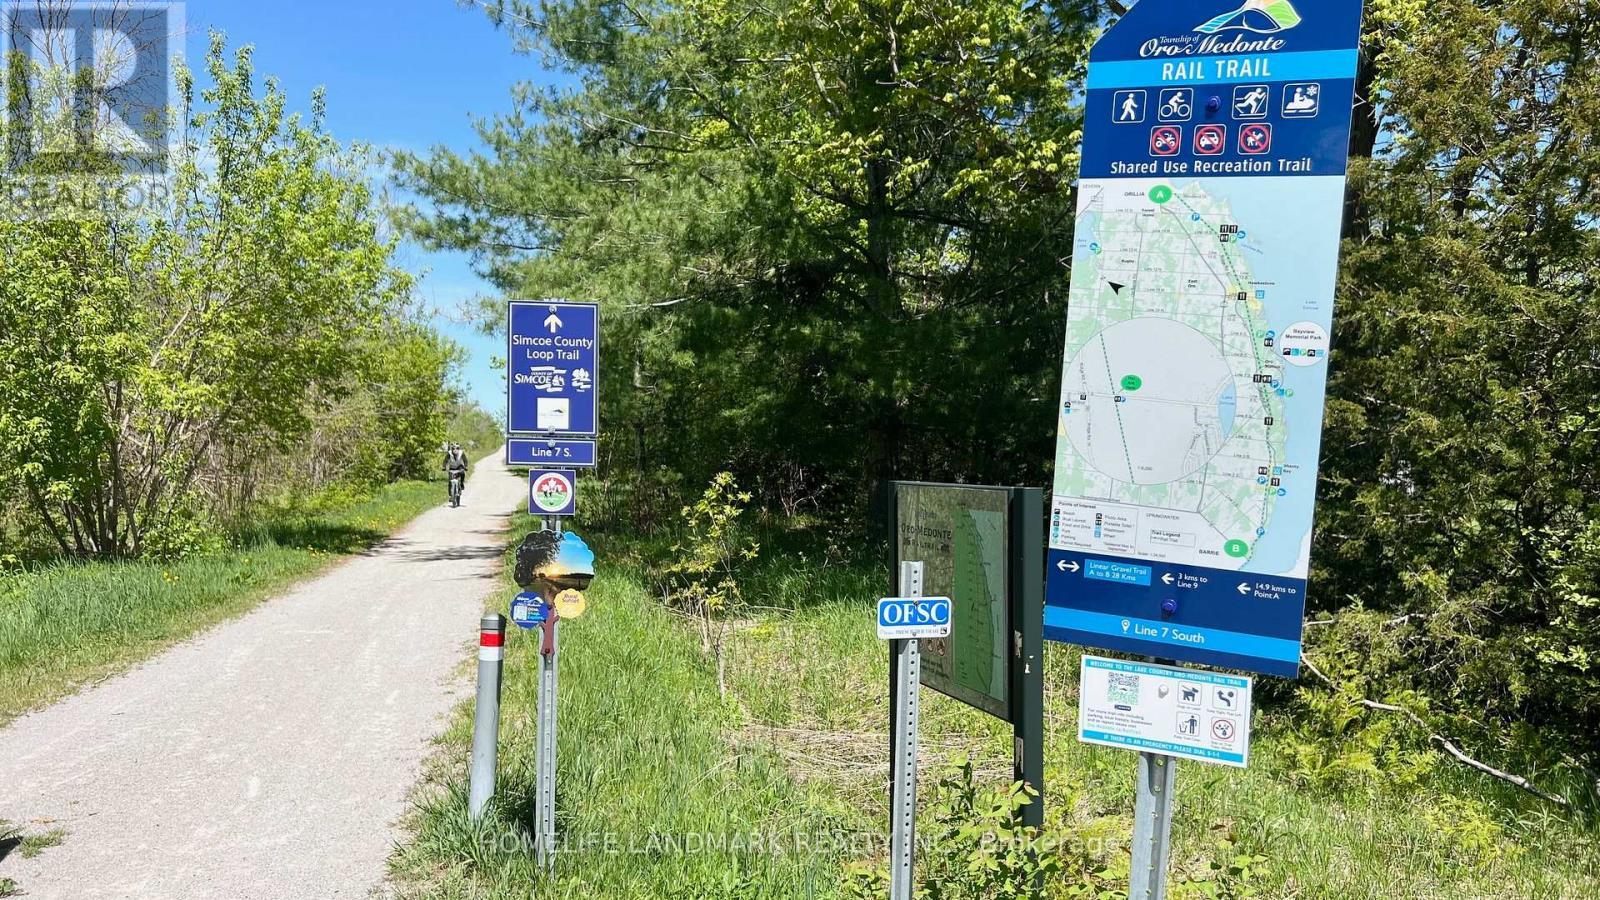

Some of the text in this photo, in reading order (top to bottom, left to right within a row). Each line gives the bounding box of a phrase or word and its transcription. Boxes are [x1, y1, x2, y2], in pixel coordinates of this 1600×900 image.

[1159, 33, 1201, 45] Township of
[1161, 57, 1272, 81] RAIL TRAIL
[1110, 157, 1312, 174] Shared Use Recreation Trail
[1155, 190, 1165, 200] A
[512, 334, 593, 350] Simcoe County
[526, 348, 580, 362] Loop Trail
[513, 373, 553, 385] SIMCOE
[531, 446, 572, 458] Line 7 S.
[1232, 544, 1240, 553] B
[1089, 562, 1147, 575] Linear Gravel Trail
[1111, 571, 1120, 579] 28
[1121, 573, 1137, 582] Kms
[1178, 572, 1208, 583] 3 kms to
[1177, 580, 1192, 589] Line
[1254, 582, 1296, 595] 14.9 kms to
[1253, 589, 1280, 600] Point A
[883, 601, 948, 625] OFSC
[1134, 623, 1205, 644] Line 7 South
[1089, 659, 1114, 668] WELCOME
[1134, 665, 1147, 673] LAKE
[1110, 734, 1125, 742] THERE
[1142, 739, 1173, 751] EMERGENCY
[1173, 743, 1192, 754] PLEASE
[1193, 748, 1206, 756] DIAL
